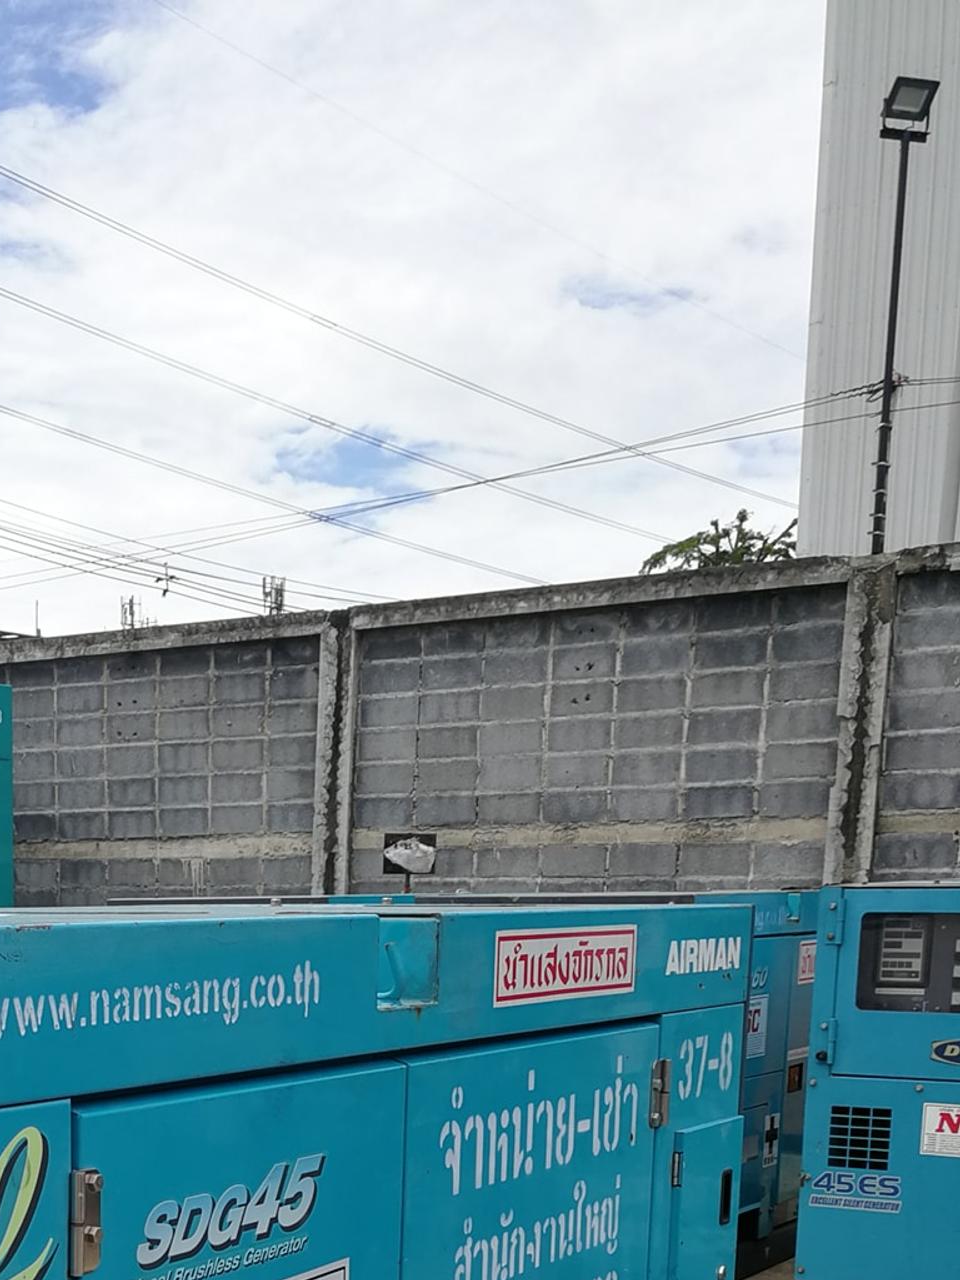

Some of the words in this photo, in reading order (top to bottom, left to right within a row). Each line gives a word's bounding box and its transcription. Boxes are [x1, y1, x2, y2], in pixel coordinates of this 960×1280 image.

[665, 937, 742, 976] AIRMAN
[678, 1031, 734, 1101] 37-8
[136, 1153, 326, 1270] SDG45
[243, 1236, 309, 1266] Generator
